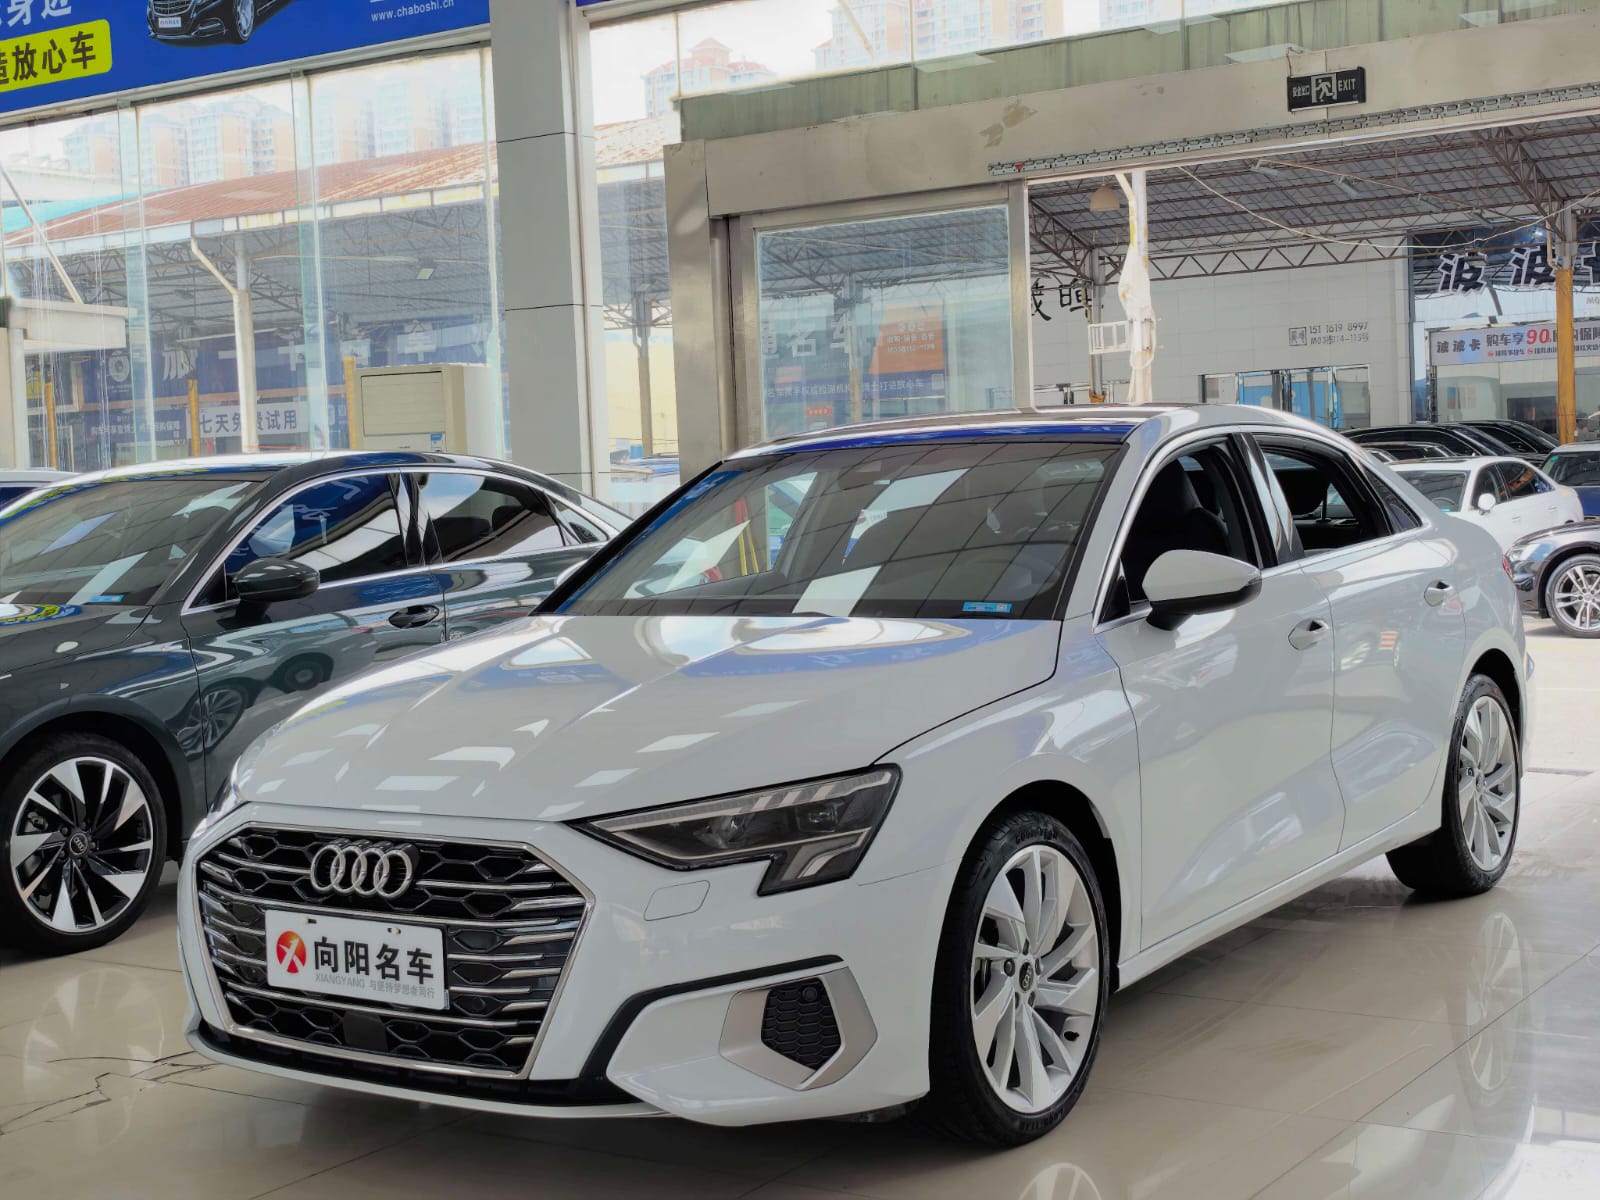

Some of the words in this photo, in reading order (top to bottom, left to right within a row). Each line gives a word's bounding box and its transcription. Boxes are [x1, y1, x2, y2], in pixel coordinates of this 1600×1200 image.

[1337, 78, 1356, 92] EXIT
[313, 936, 434, 985] 向阳名车
[315, 973, 365, 988] XIANGYANG
